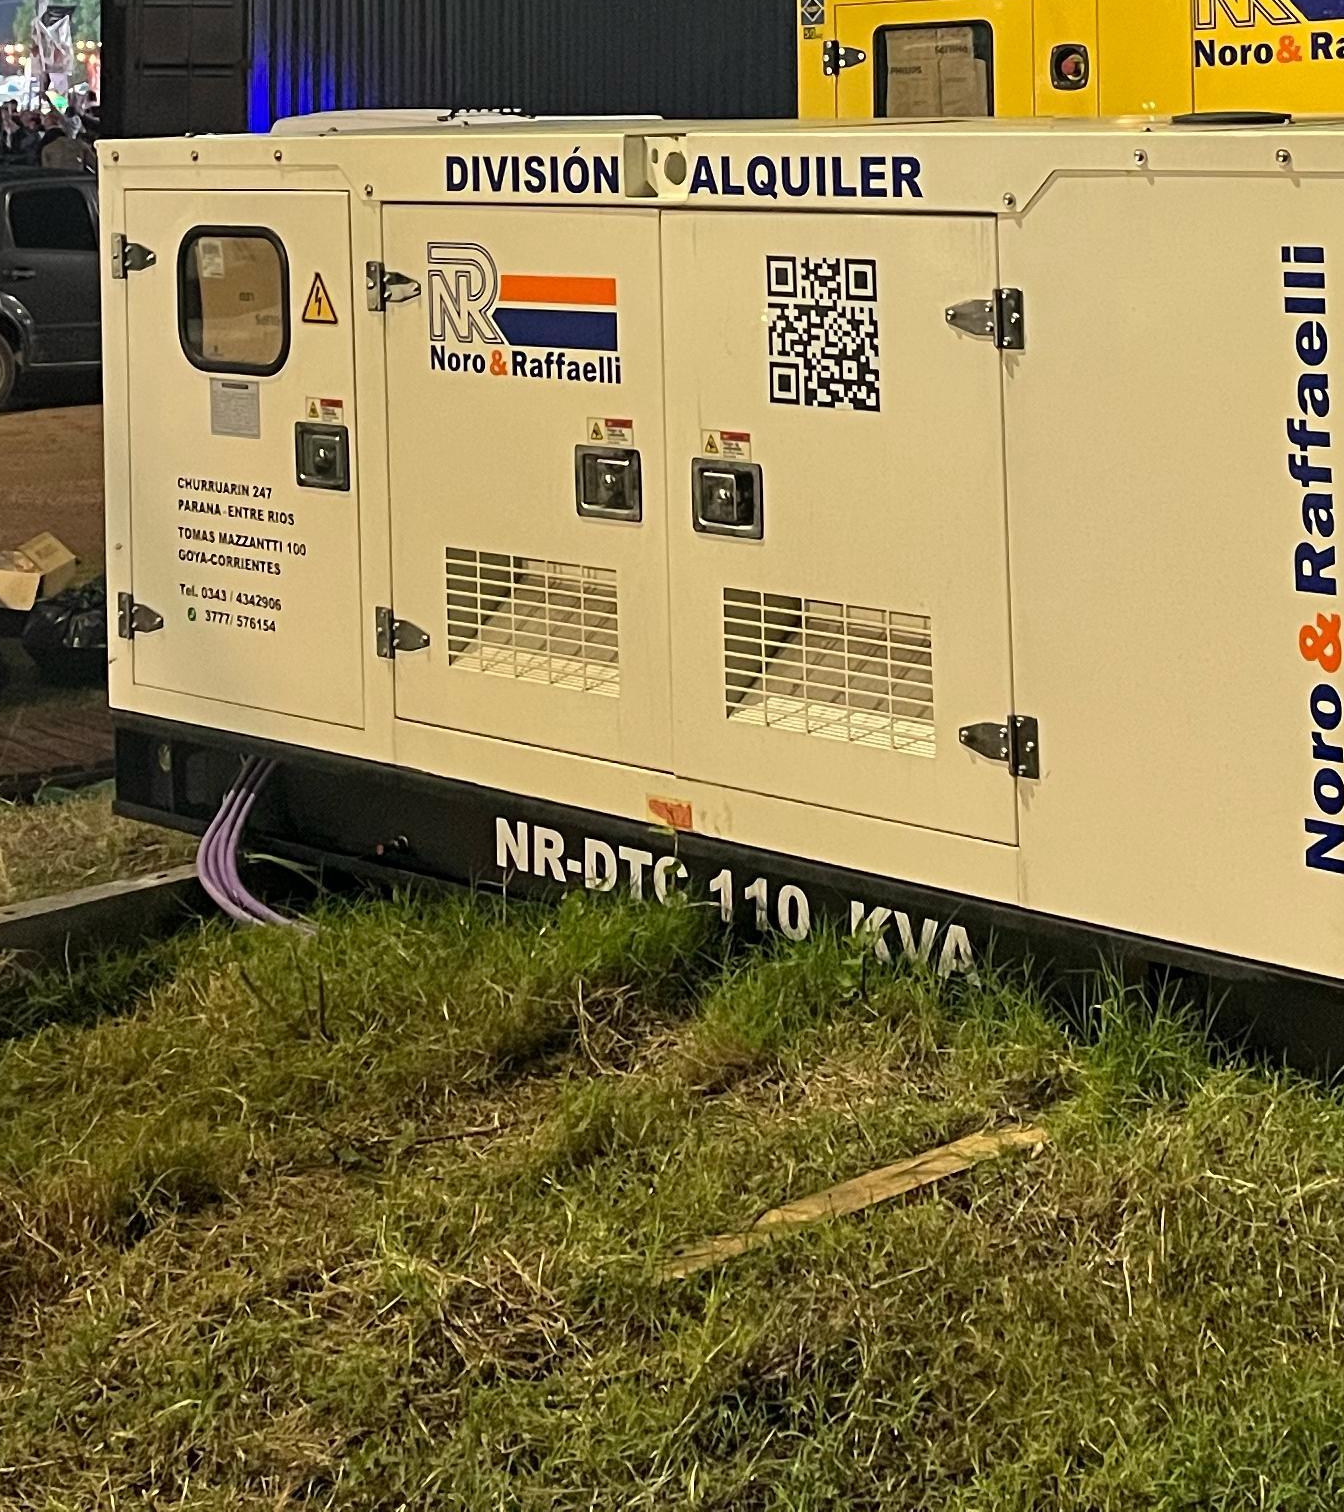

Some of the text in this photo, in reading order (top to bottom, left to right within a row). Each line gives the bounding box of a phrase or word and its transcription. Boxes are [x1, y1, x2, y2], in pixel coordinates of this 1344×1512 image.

[1194, 40, 1273, 68] Noro
[1276, 35, 1303, 64] &
[446, 146, 923, 199] DIVISIÓN ALQUILER
[430, 344, 622, 384] Noro & Raffaelli
[1281, 246, 1337, 595] Raffaelli
[177, 477, 273, 500] CHURRUARIN 247
[268, 510, 295, 526] RIOS
[178, 526, 307, 557] TOMAS MAZZANTTI 100
[178, 549, 281, 575] GOYA-CORRIENTES
[201, 586, 227, 602] 0343
[236, 592, 282, 611] 4342906
[236, 617, 276, 632] 576154
[1298, 612, 1342, 673] &
[709, 869, 810, 941] 110
[851, 900, 982, 987] KVA
